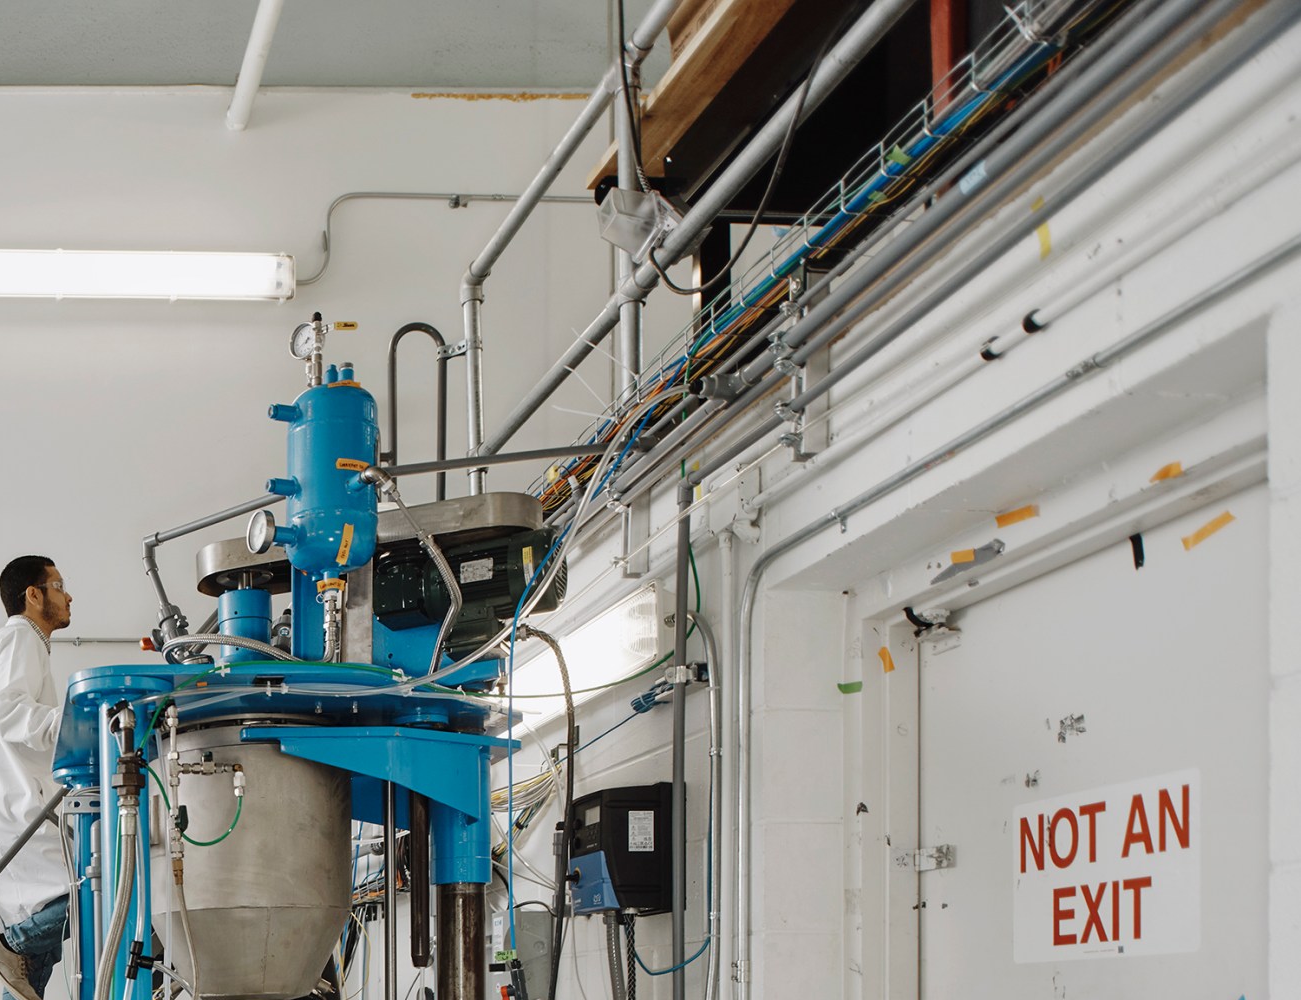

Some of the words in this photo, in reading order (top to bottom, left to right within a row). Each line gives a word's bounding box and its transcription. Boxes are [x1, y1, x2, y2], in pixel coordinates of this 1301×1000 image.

[1019, 801, 1106, 873] NOT
[1121, 783, 1190, 858] AN
[1052, 876, 1152, 946] EXIT
